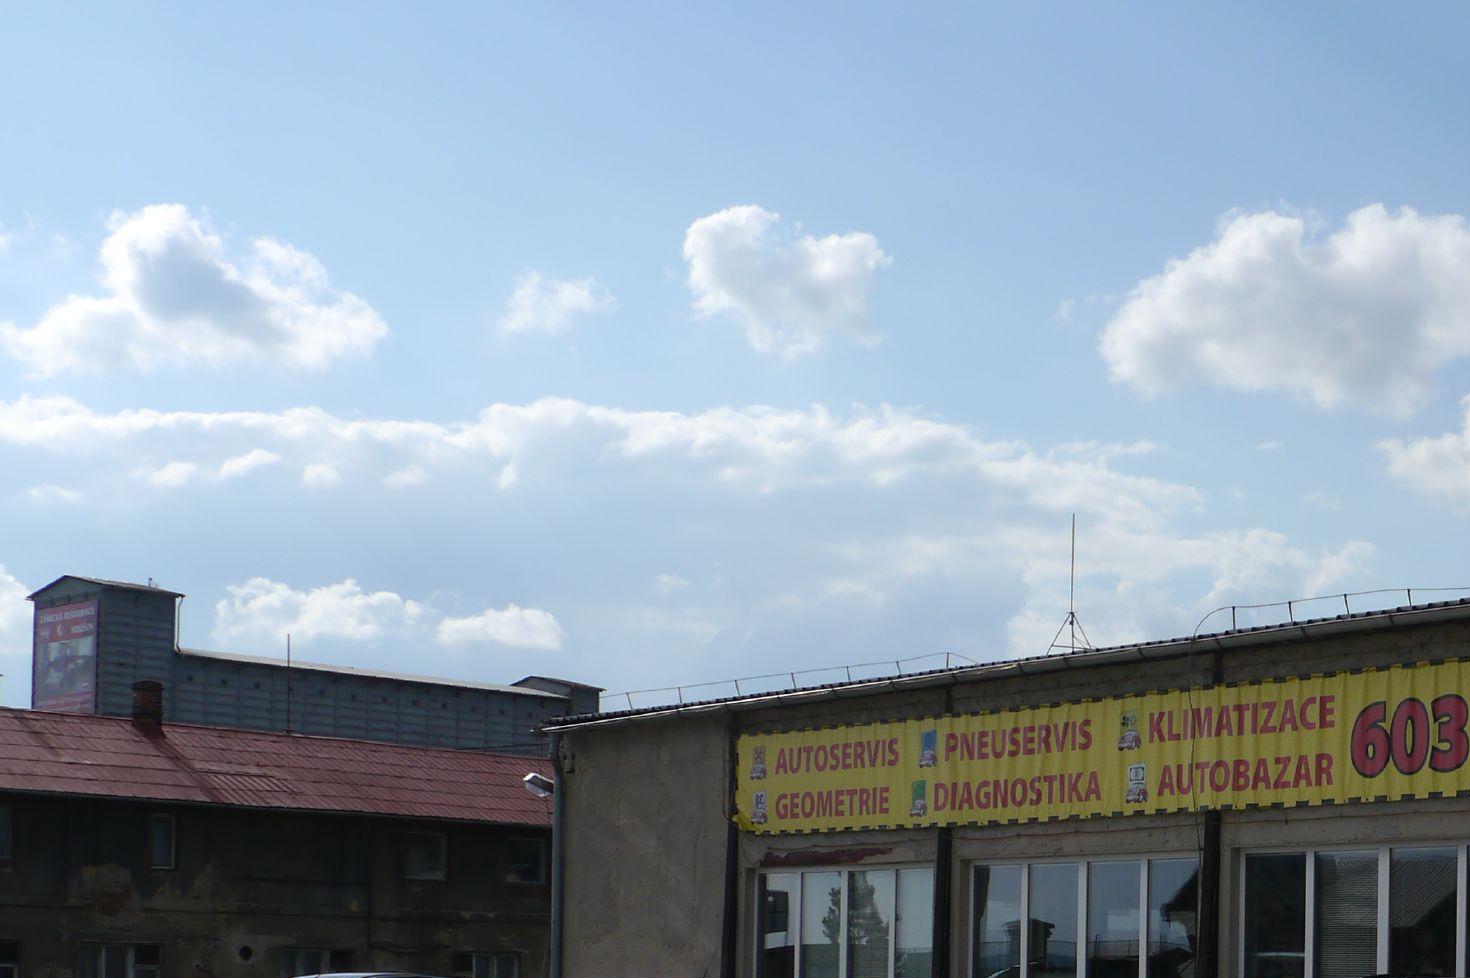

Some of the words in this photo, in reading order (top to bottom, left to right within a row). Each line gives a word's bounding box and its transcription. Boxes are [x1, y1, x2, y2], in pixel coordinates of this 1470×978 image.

[944, 718, 1093, 761] PNEUSERVIS
[1148, 695, 1336, 743] KLIMATIZACE
[1350, 694, 1470, 778] 603
[774, 737, 900, 775] AUTOSERVIS
[1157, 753, 1335, 797] AUTOBAZAR
[774, 786, 890, 820] GEOMETRIE
[932, 771, 1102, 812] DIAGNOSTIKA
